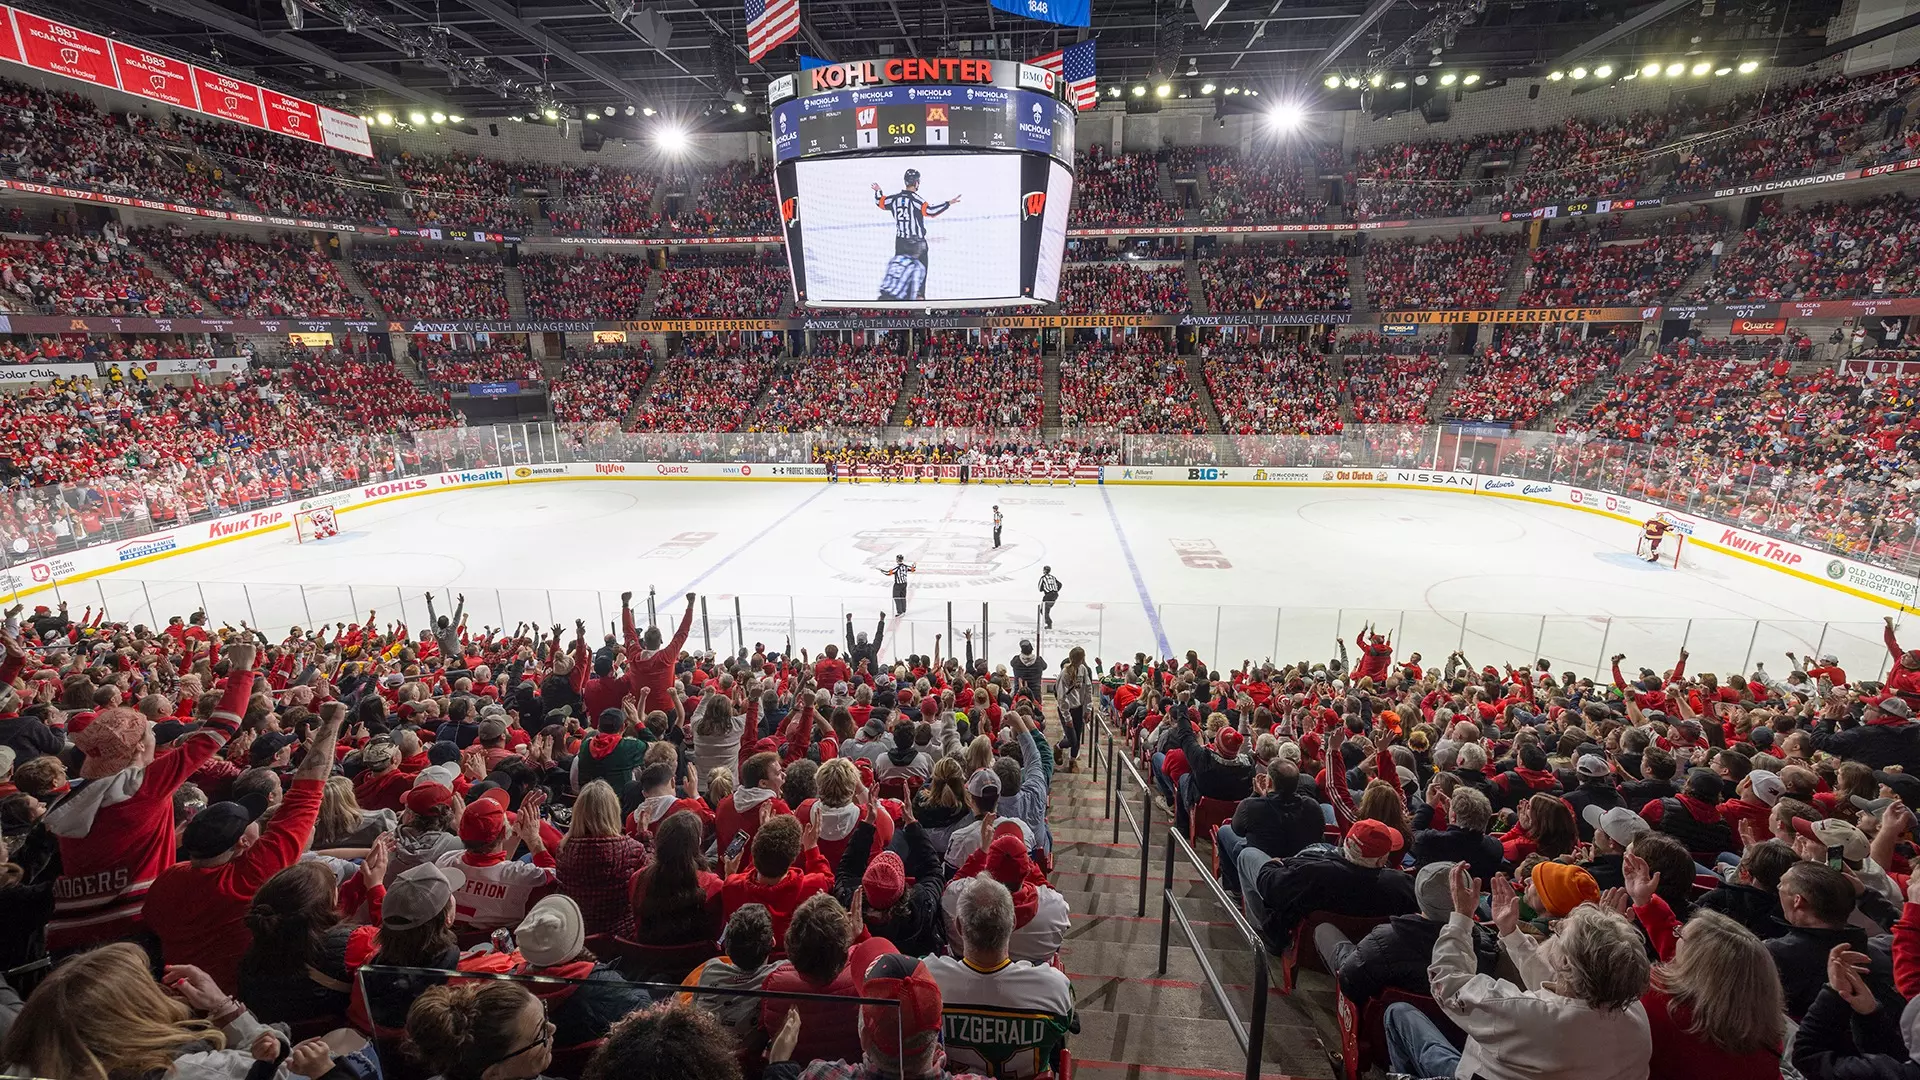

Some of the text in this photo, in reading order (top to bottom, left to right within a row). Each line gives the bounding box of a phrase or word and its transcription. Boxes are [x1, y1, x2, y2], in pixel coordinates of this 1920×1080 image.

[1028, 0, 1048, 14] 1848
[48, 24, 79, 41] 1981
[29, 28, 101, 55] NCAA Champions
[140, 53, 166, 68] 1983
[50, 62, 97, 81] Men's Hockey
[125, 58, 184, 80] NCAA Champions
[811, 61, 879, 90] KOHL
[884, 58, 993, 83] CENTER
[1023, 70, 1043, 83] BMO
[217, 77, 239, 90] 1990
[142, 88, 180, 104] Men's Hockey
[204, 82, 254, 101] NCAA Champions
[860, 91, 893, 100] NICHOLAS
[917, 89, 952, 97] NICHOLAS
[975, 90, 1008, 100] NICHOLAS
[810, 96, 840, 106] NICHOLAS
[888, 123, 916, 135] 6:10
[934, 129, 941, 141] 1
[1019, 123, 1052, 136] NICHOLAS
[865, 131, 870, 143] 1
[893, 136, 911, 144] 2ND
[1867, 163, 1895, 176] 1972
[19, 182, 53, 195] 1973
[1714, 172, 1846, 198] BIG TEN CHAMPIONS
[63, 188, 92, 200] 1977
[102, 194, 131, 205] 1978
[140, 199, 165, 210] 1982
[173, 204, 197, 214] 1983
[332, 223, 356, 232] 2013
[1380, 312, 1432, 323] KNOW
[1439, 312, 1470, 323] THE
[1678, 311, 1696, 319] 2/4
[1736, 309, 1754, 318] 0/1
[1801, 308, 1813, 317] 12
[1864, 307, 1876, 316] 10
[411, 320, 596, 332] ANNEX WEALTH MANAGEMENT
[620, 320, 663, 331] KNOW
[667, 320, 691, 331] THE
[803, 318, 959, 329] ANNEX WEALTH MANAGEMENT
[982, 317, 1025, 328] KNOW
[1030, 317, 1055, 327] THE
[1179, 314, 1352, 326] ANNEX WEALTH MANAGEMENT
[1742, 321, 1775, 331] Quartz
[159, 324, 172, 332] 24
[0, 368, 56, 379] Solar Club
[657, 464, 689, 476] Quartz
[813, 467, 827, 476] HOUS
[1336, 471, 1373, 480] Old Dutch
[1397, 472, 1474, 486] NISSAN
[1484, 479, 1516, 490] Culver's
[365, 479, 428, 499] KOHL'S
[1522, 484, 1553, 495] Culver's
[251, 511, 283, 528] TRIP
[938, 518, 994, 526] CENTE
[119, 539, 175, 556] AMERICAN FAMILY
[1761, 540, 1803, 565] TRIP
[51, 561, 74, 572] credit
[52, 567, 76, 577] union
[868, 579, 960, 590] JONSON
[1848, 566, 1918, 593] OLD DOMINION
[1849, 575, 1913, 601] FREIGHT LINE
[943, 1013, 1045, 1045] ITZGERALD
